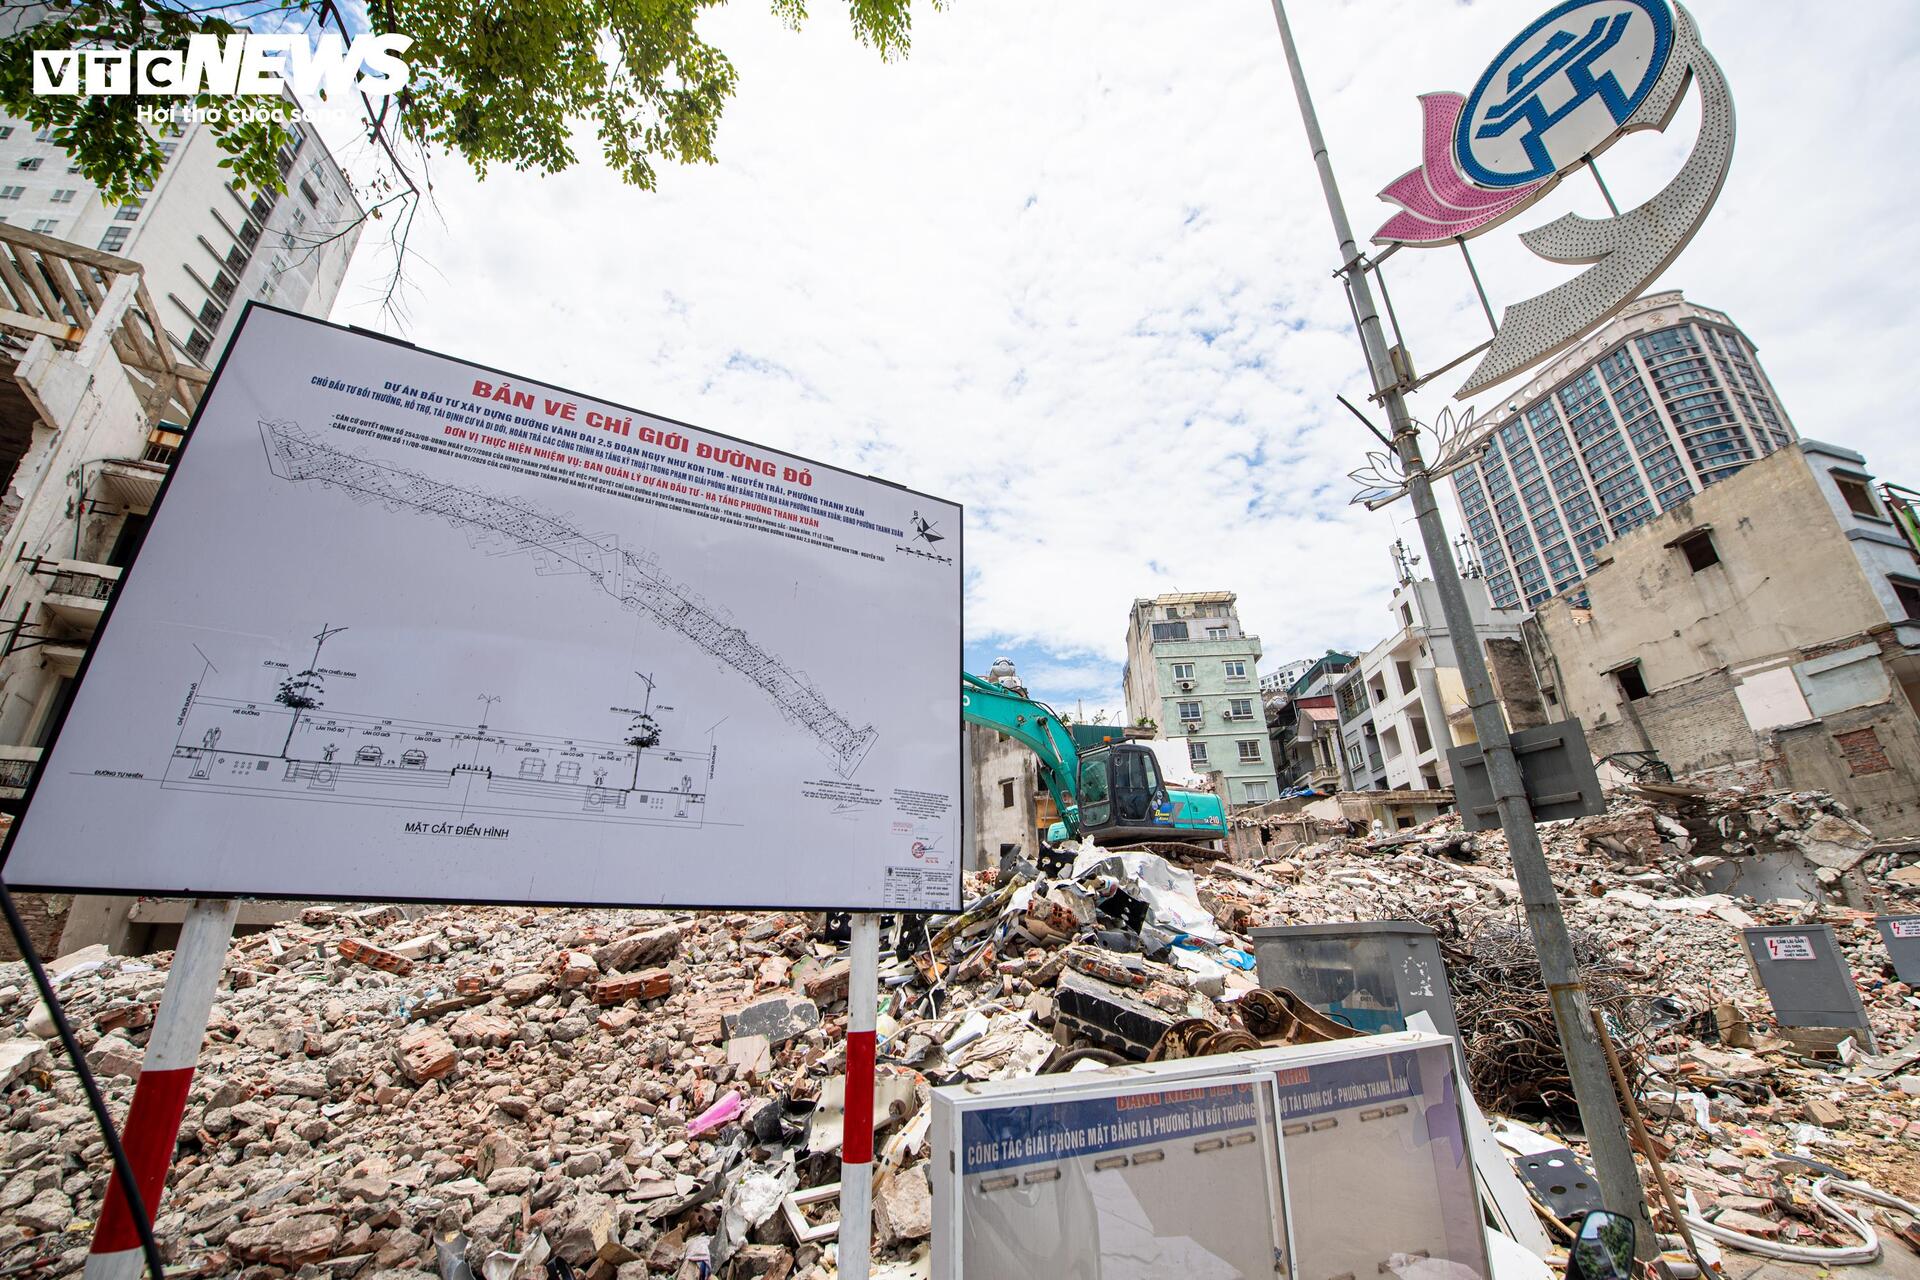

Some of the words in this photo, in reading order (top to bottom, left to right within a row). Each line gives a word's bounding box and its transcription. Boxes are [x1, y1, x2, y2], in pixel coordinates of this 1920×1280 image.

[384, 381, 402, 393] DỰ
[401, 385, 418, 397] ÁN
[420, 391, 443, 403] ĐẦU
[445, 397, 460, 408] TƯ
[460, 402, 482, 414] XÂY
[483, 408, 512, 422] DỰNG
[514, 416, 549, 431] ĐƯỜNG
[551, 425, 577, 439] VÀNH
[579, 433, 596, 443] ĐAI
[614, 442, 640, 456] ĐOẠN
[667, 457, 687, 468] NHƯ
[687, 462, 705, 473] KON
[706, 467, 724, 478] TUM
[731, 474, 764, 489] NGUYỄN
[787, 489, 818, 504] PHƯỜNG
[819, 498, 843, 511] THANH
[845, 505, 864, 517] XUÂN
[444, 425, 467, 438] ĐƠN
[469, 431, 479, 443] VỊ
[481, 434, 506, 448] THỰC
[508, 441, 532, 454] HIỆN
[533, 447, 565, 463] NHIỆM
[567, 456, 582, 467] VỤ:
[583, 460, 603, 472] BAN
[604, 465, 629, 479] QUẢN
[630, 472, 641, 482] LÝ
[642, 475, 656, 487] DỰ
[656, 478, 668, 489] ÁN
[670, 482, 687, 494] ĐẦU
[689, 487, 700, 497] TƯ
[705, 492, 716, 502] HẠ
[718, 494, 739, 507] TẦNG
[740, 500, 772, 515] PHƯỜNG
[773, 508, 798, 522] THANH
[799, 515, 819, 528] XUÂN
[472, 380, 535, 410] BẢN
[545, 399, 577, 421] VẼ
[585, 412, 632, 436] CHỈ
[638, 427, 689, 453] GIỚI
[696, 442, 776, 477] ĐƯỜNG
[783, 467, 812, 486] ĐỎ
[405, 822, 429, 834] MẶT
[431, 822, 454, 834] CẮT
[455, 823, 481, 836] ĐIỂN
[483, 826, 509, 838] HÌNH
[968, 1140, 999, 1166] CÔNG
[1001, 1137, 1022, 1160] TÁC
[1025, 1130, 1048, 1157] GIẢI
[1050, 1128, 1086, 1152] PHÓNG
[1087, 1123, 1109, 1149] MẶT
[1111, 1117, 1137, 1141] BẰNG
[1140, 1115, 1152, 1136] VÀ
[1153, 1112, 1190, 1134] PHƯƠNG
[1223, 1101, 1256, 1123] THƯỜNG
[1288, 1092, 1302, 1112] TÁI
[1303, 1093, 1322, 1113] ĐỊNH
[1322, 1088, 1333, 1105] CƯ
[1338, 1082, 1367, 1104] PHƯỜNG
[1368, 1080, 1390, 1097] THANH
